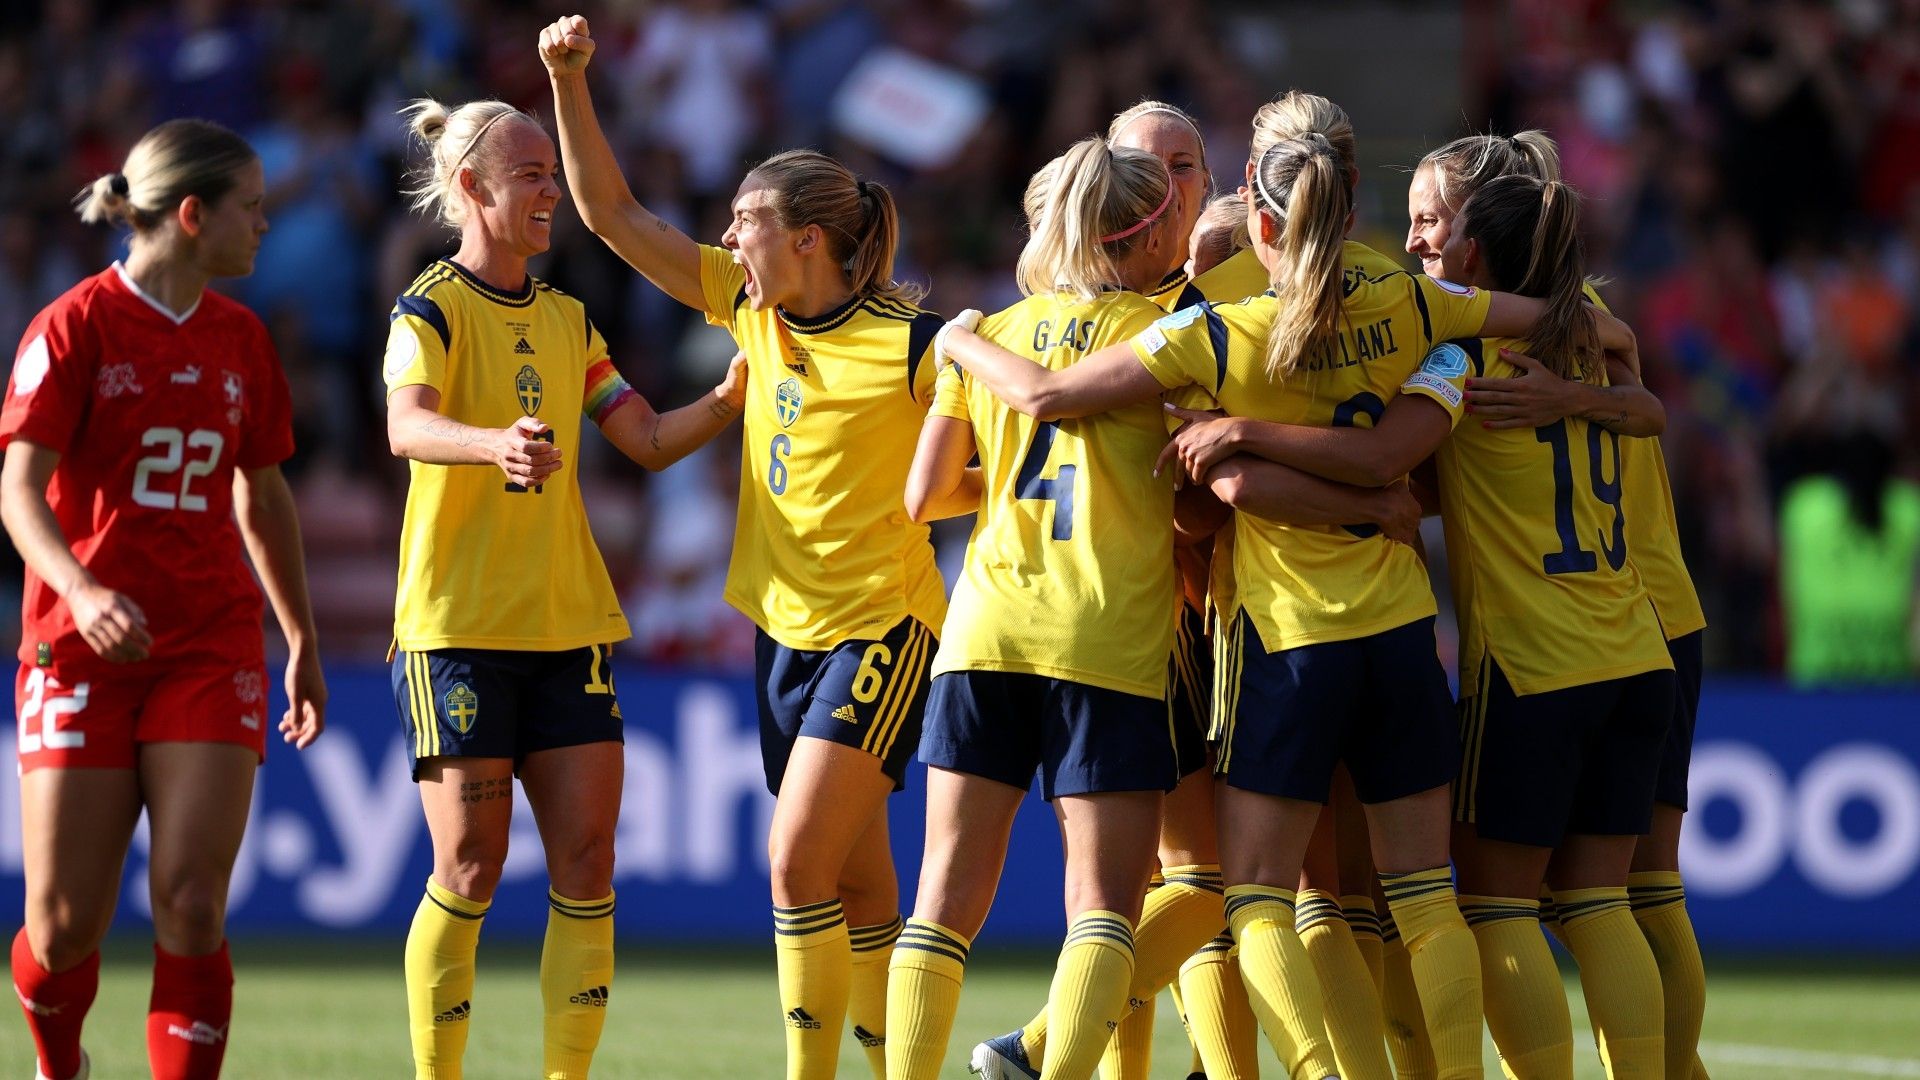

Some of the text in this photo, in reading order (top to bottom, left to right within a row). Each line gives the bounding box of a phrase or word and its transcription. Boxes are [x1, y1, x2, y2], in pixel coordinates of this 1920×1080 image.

[1296, 317, 1398, 372] SLLANI
[132, 427, 224, 511] 22
[768, 434, 791, 495] 6
[1015, 418, 1076, 541] 4
[1536, 417, 1627, 574] 19
[584, 645, 616, 696] 1
[851, 642, 892, 704] 6
[19, 667, 90, 754] 22
[831, 711, 858, 724] adidas
